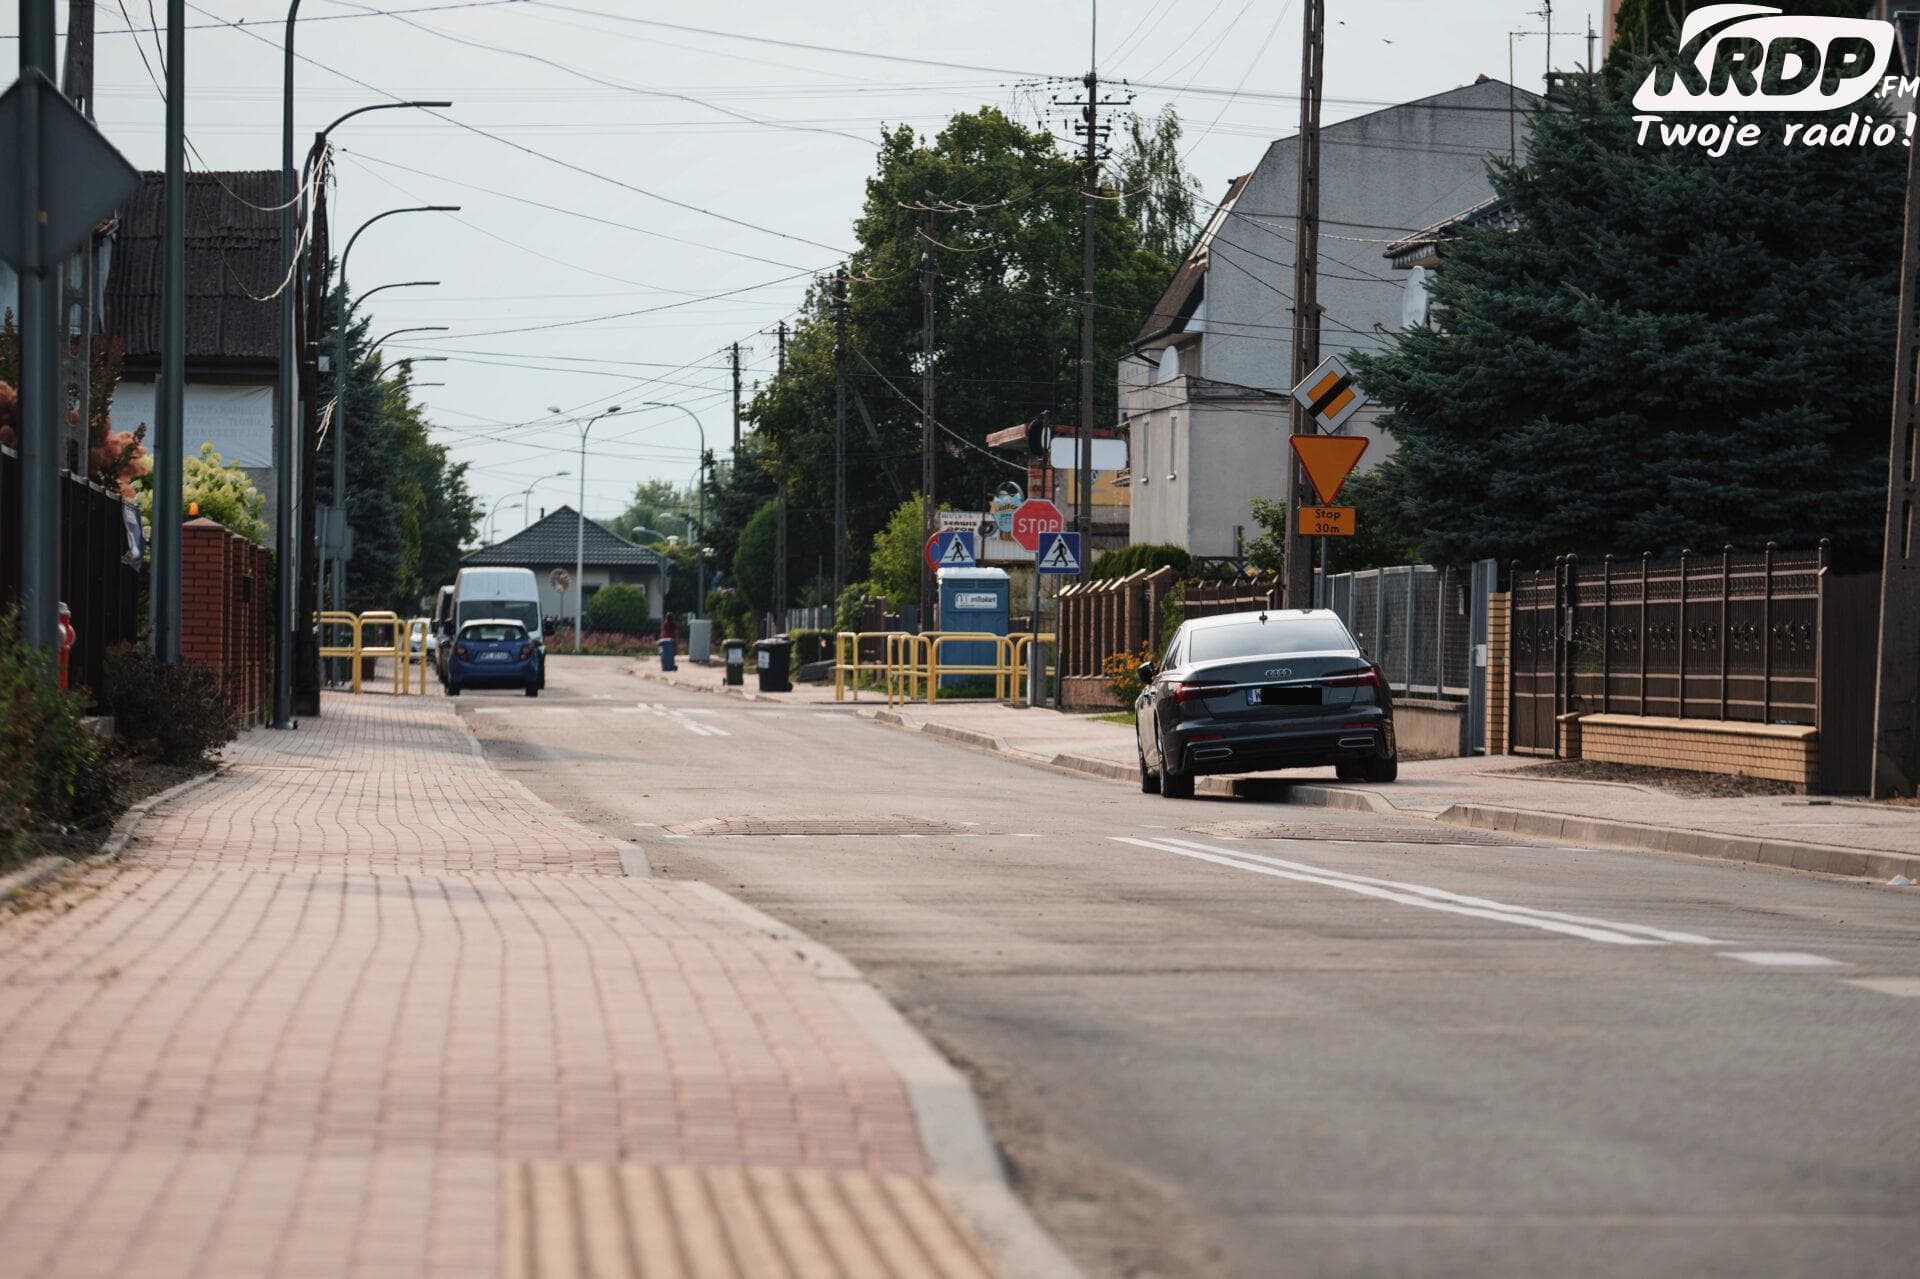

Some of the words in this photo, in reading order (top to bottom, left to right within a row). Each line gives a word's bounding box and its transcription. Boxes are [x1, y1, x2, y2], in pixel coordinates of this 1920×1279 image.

[1315, 508, 1341, 521] Stop
[1018, 518, 1059, 534] STOP
[1315, 523, 1340, 533] 30m
